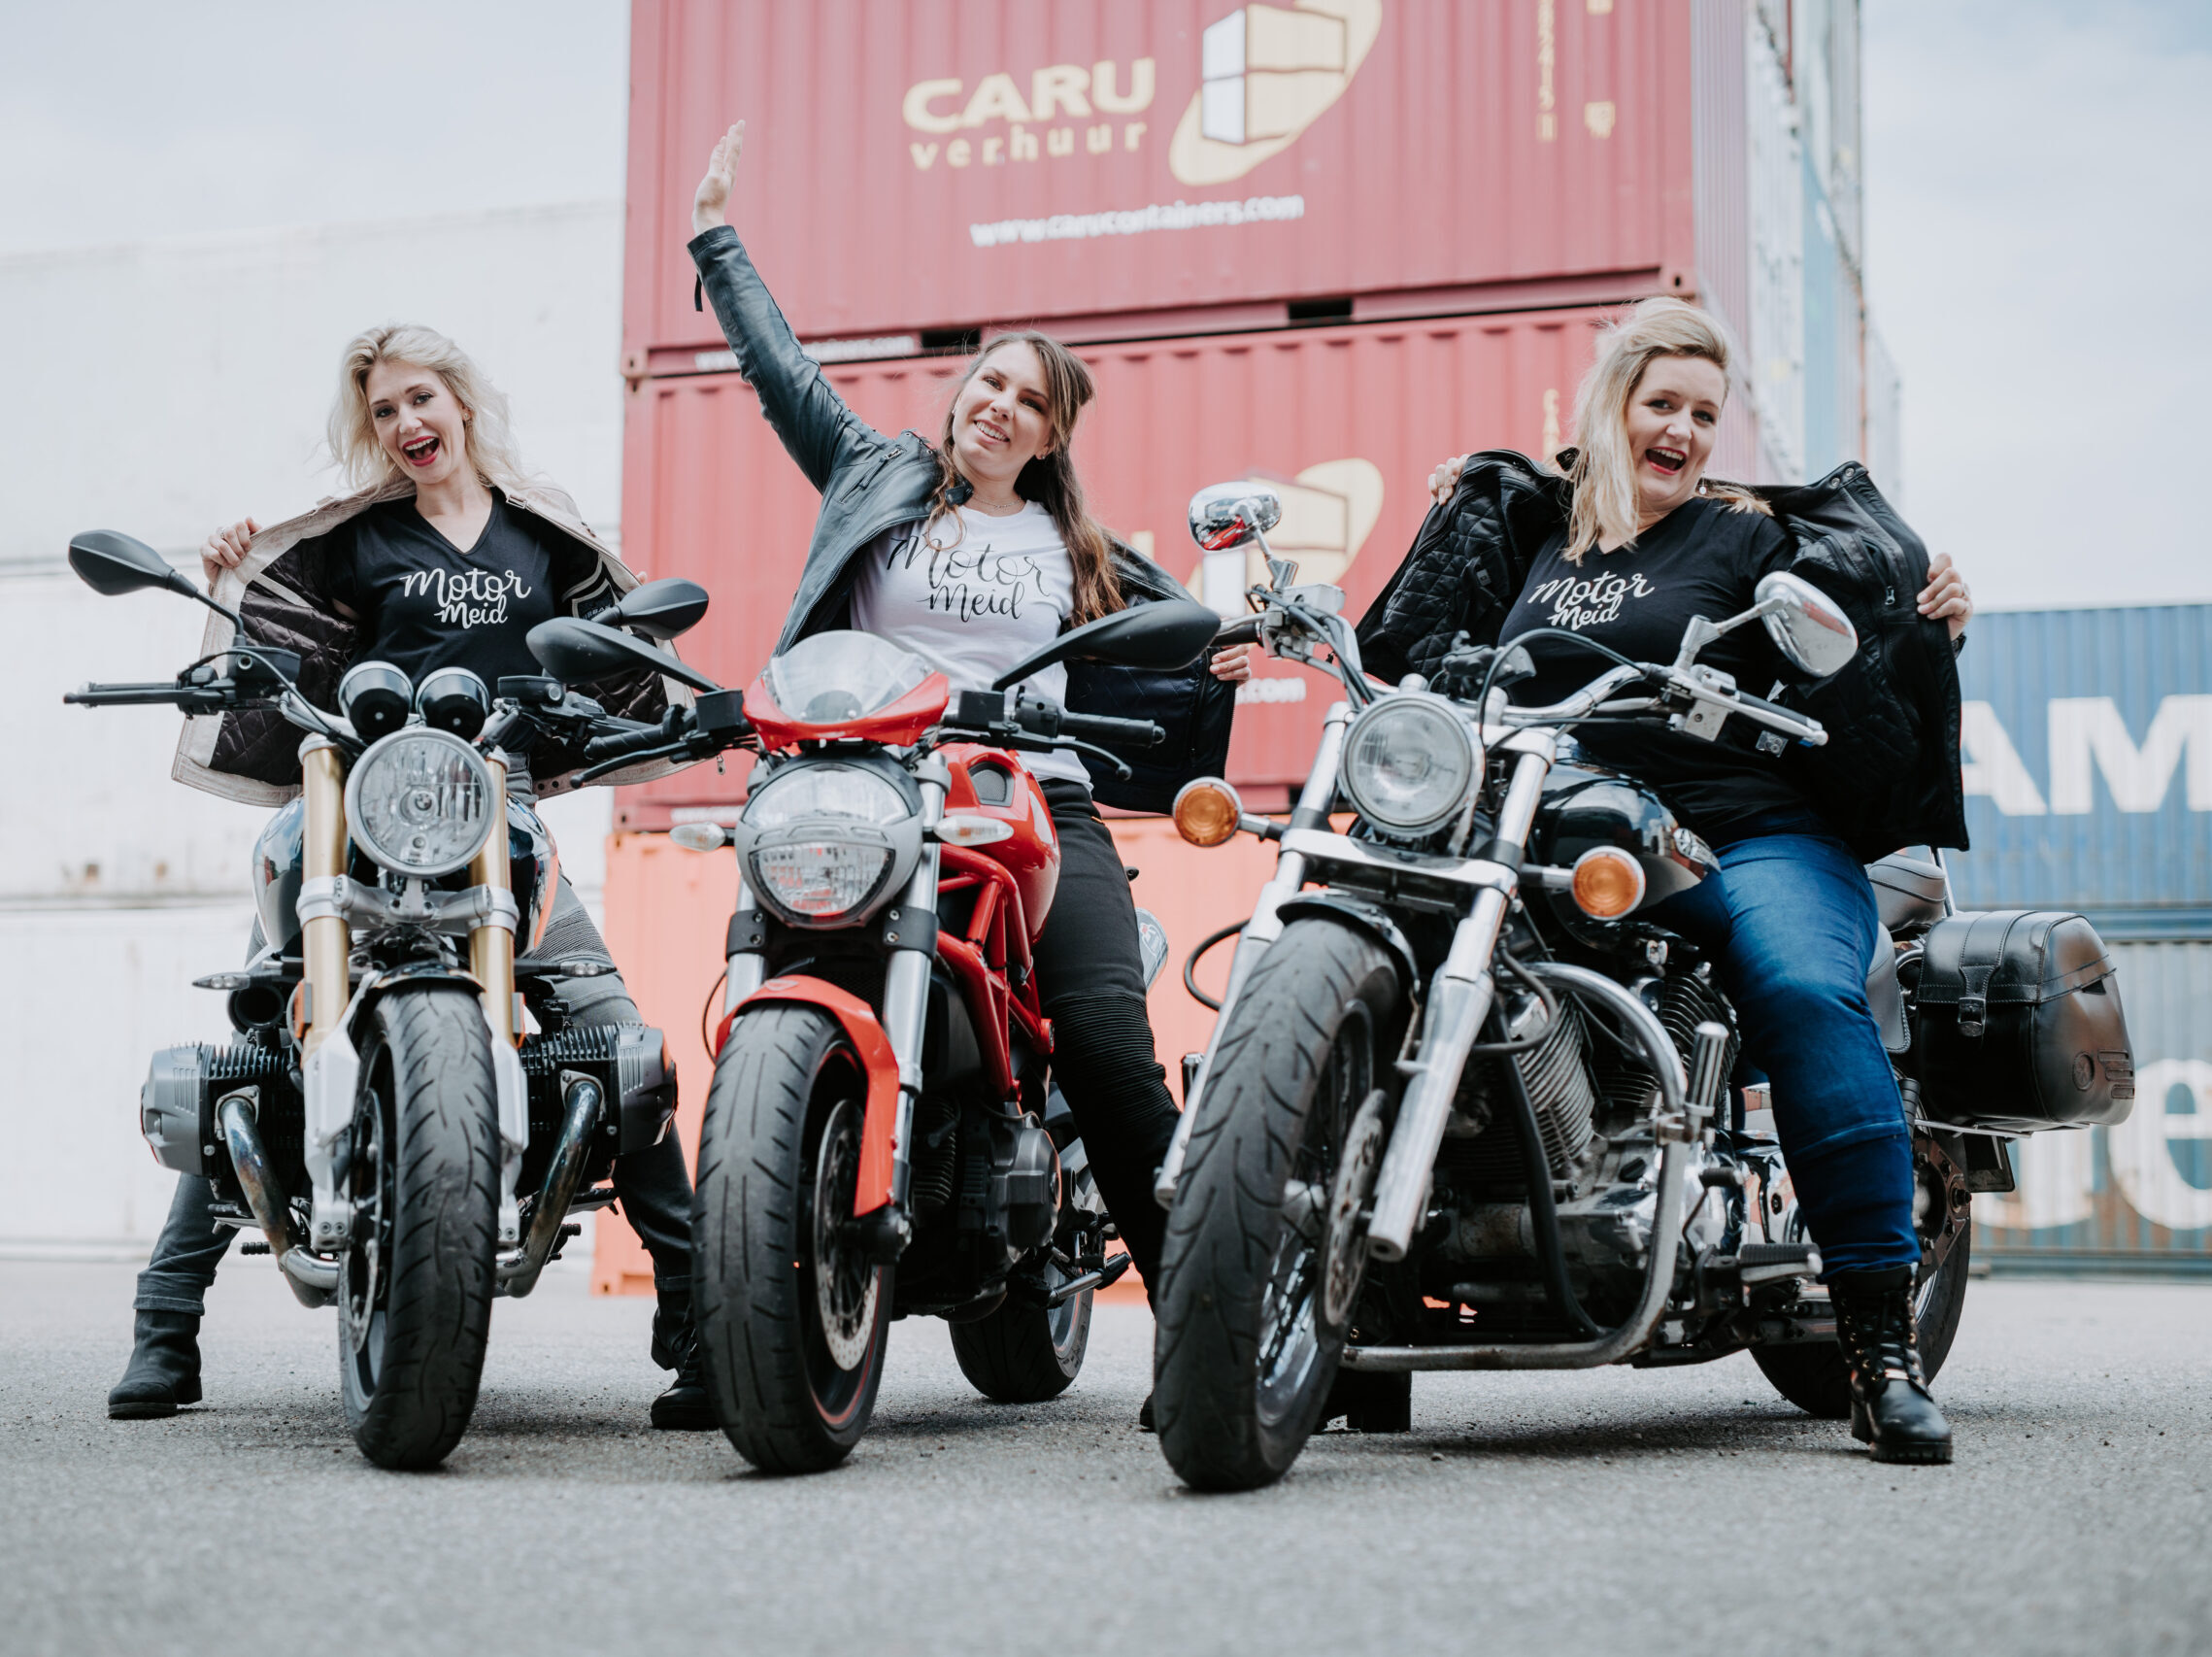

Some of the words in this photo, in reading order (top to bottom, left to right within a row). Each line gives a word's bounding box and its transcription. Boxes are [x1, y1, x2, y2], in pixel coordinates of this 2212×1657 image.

[903, 56, 1156, 134] CARU
[909, 121, 1148, 171] verhuur
[399, 567, 532, 608] Motor
[887, 535, 1051, 597] Motor
[1526, 571, 1656, 613] Motor
